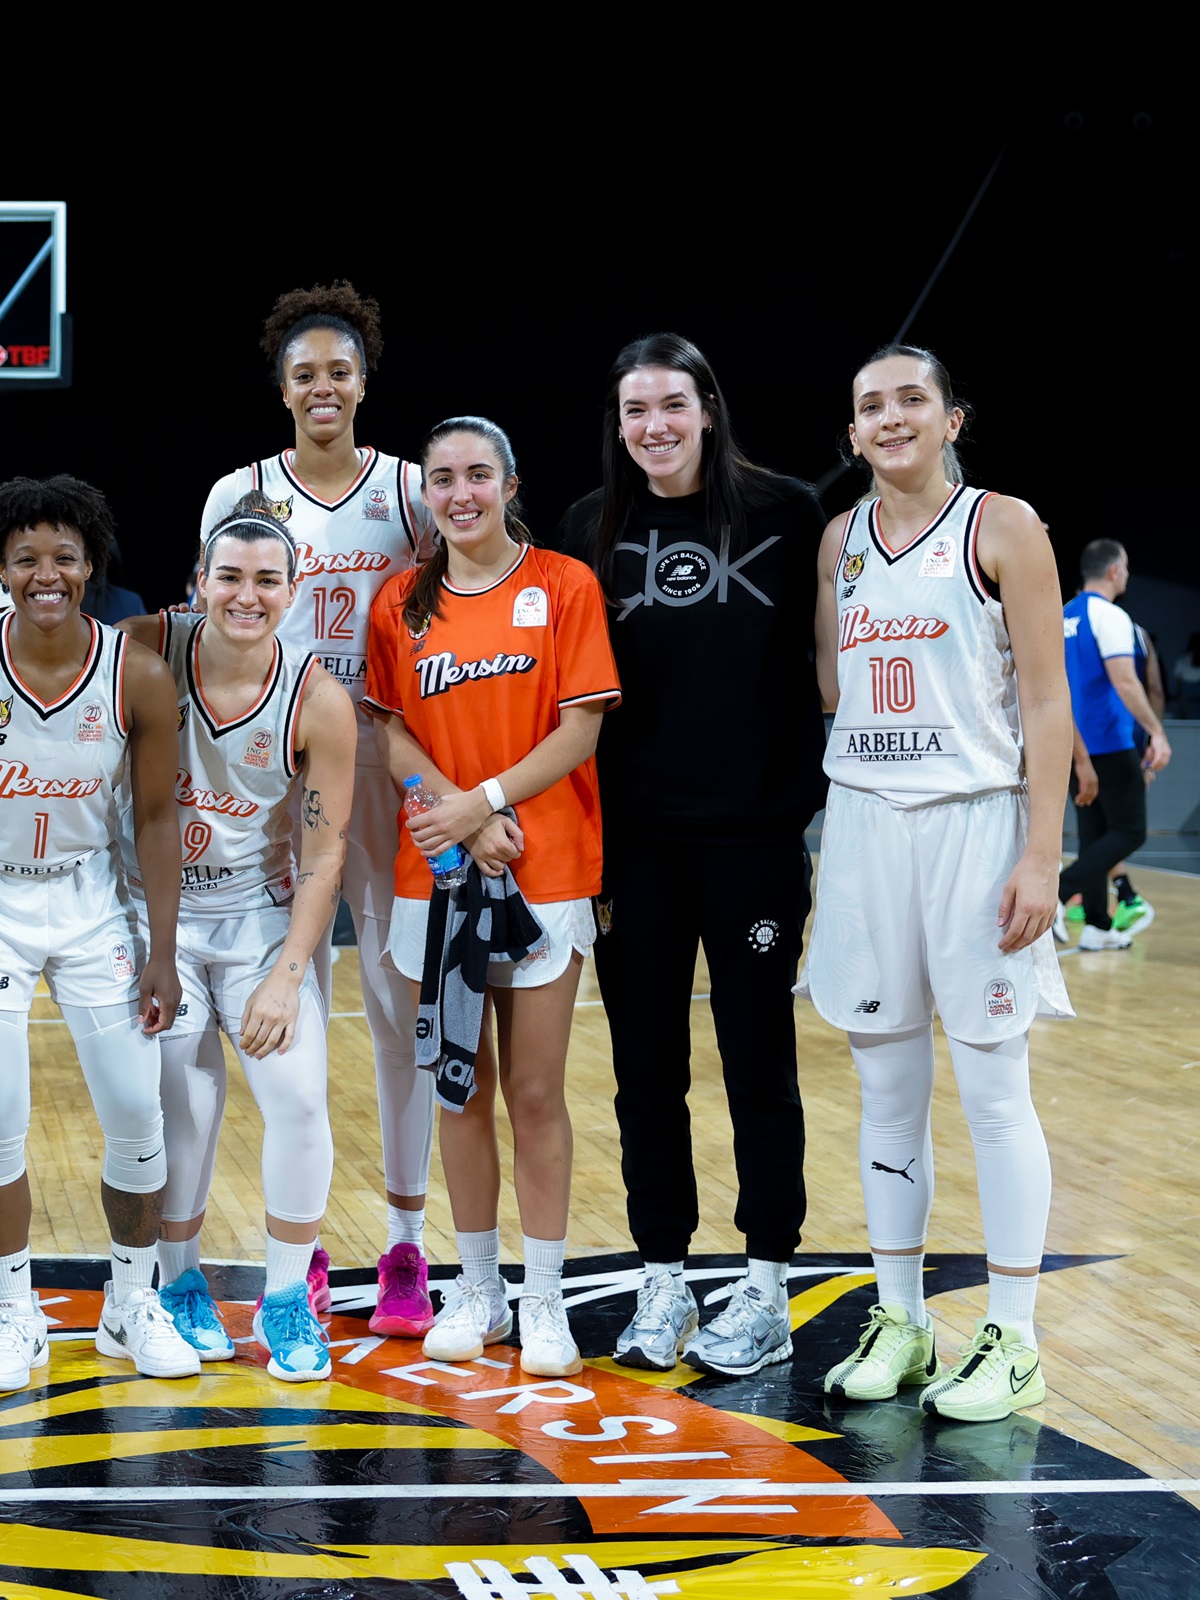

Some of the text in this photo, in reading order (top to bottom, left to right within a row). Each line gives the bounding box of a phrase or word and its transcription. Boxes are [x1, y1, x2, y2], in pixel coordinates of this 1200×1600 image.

[7, 345, 50, 367] TBF
[658, 552, 707, 572] LIFE IN BALANCE
[662, 582, 701, 596] SINCE 1906
[312, 586, 356, 640] 12
[839, 604, 950, 653] Mersin
[318, 653, 368, 677] ELLA
[415, 651, 538, 700] Mersin
[869, 656, 916, 715] 10
[246, 746, 261, 755] ING
[846, 731, 943, 754] ARBELLA
[860, 753, 921, 762] MAKARNA
[33, 811, 50, 860] 1
[183, 821, 212, 864] 9
[182, 864, 234, 886] ELLA
[182, 882, 218, 891] ARNA
